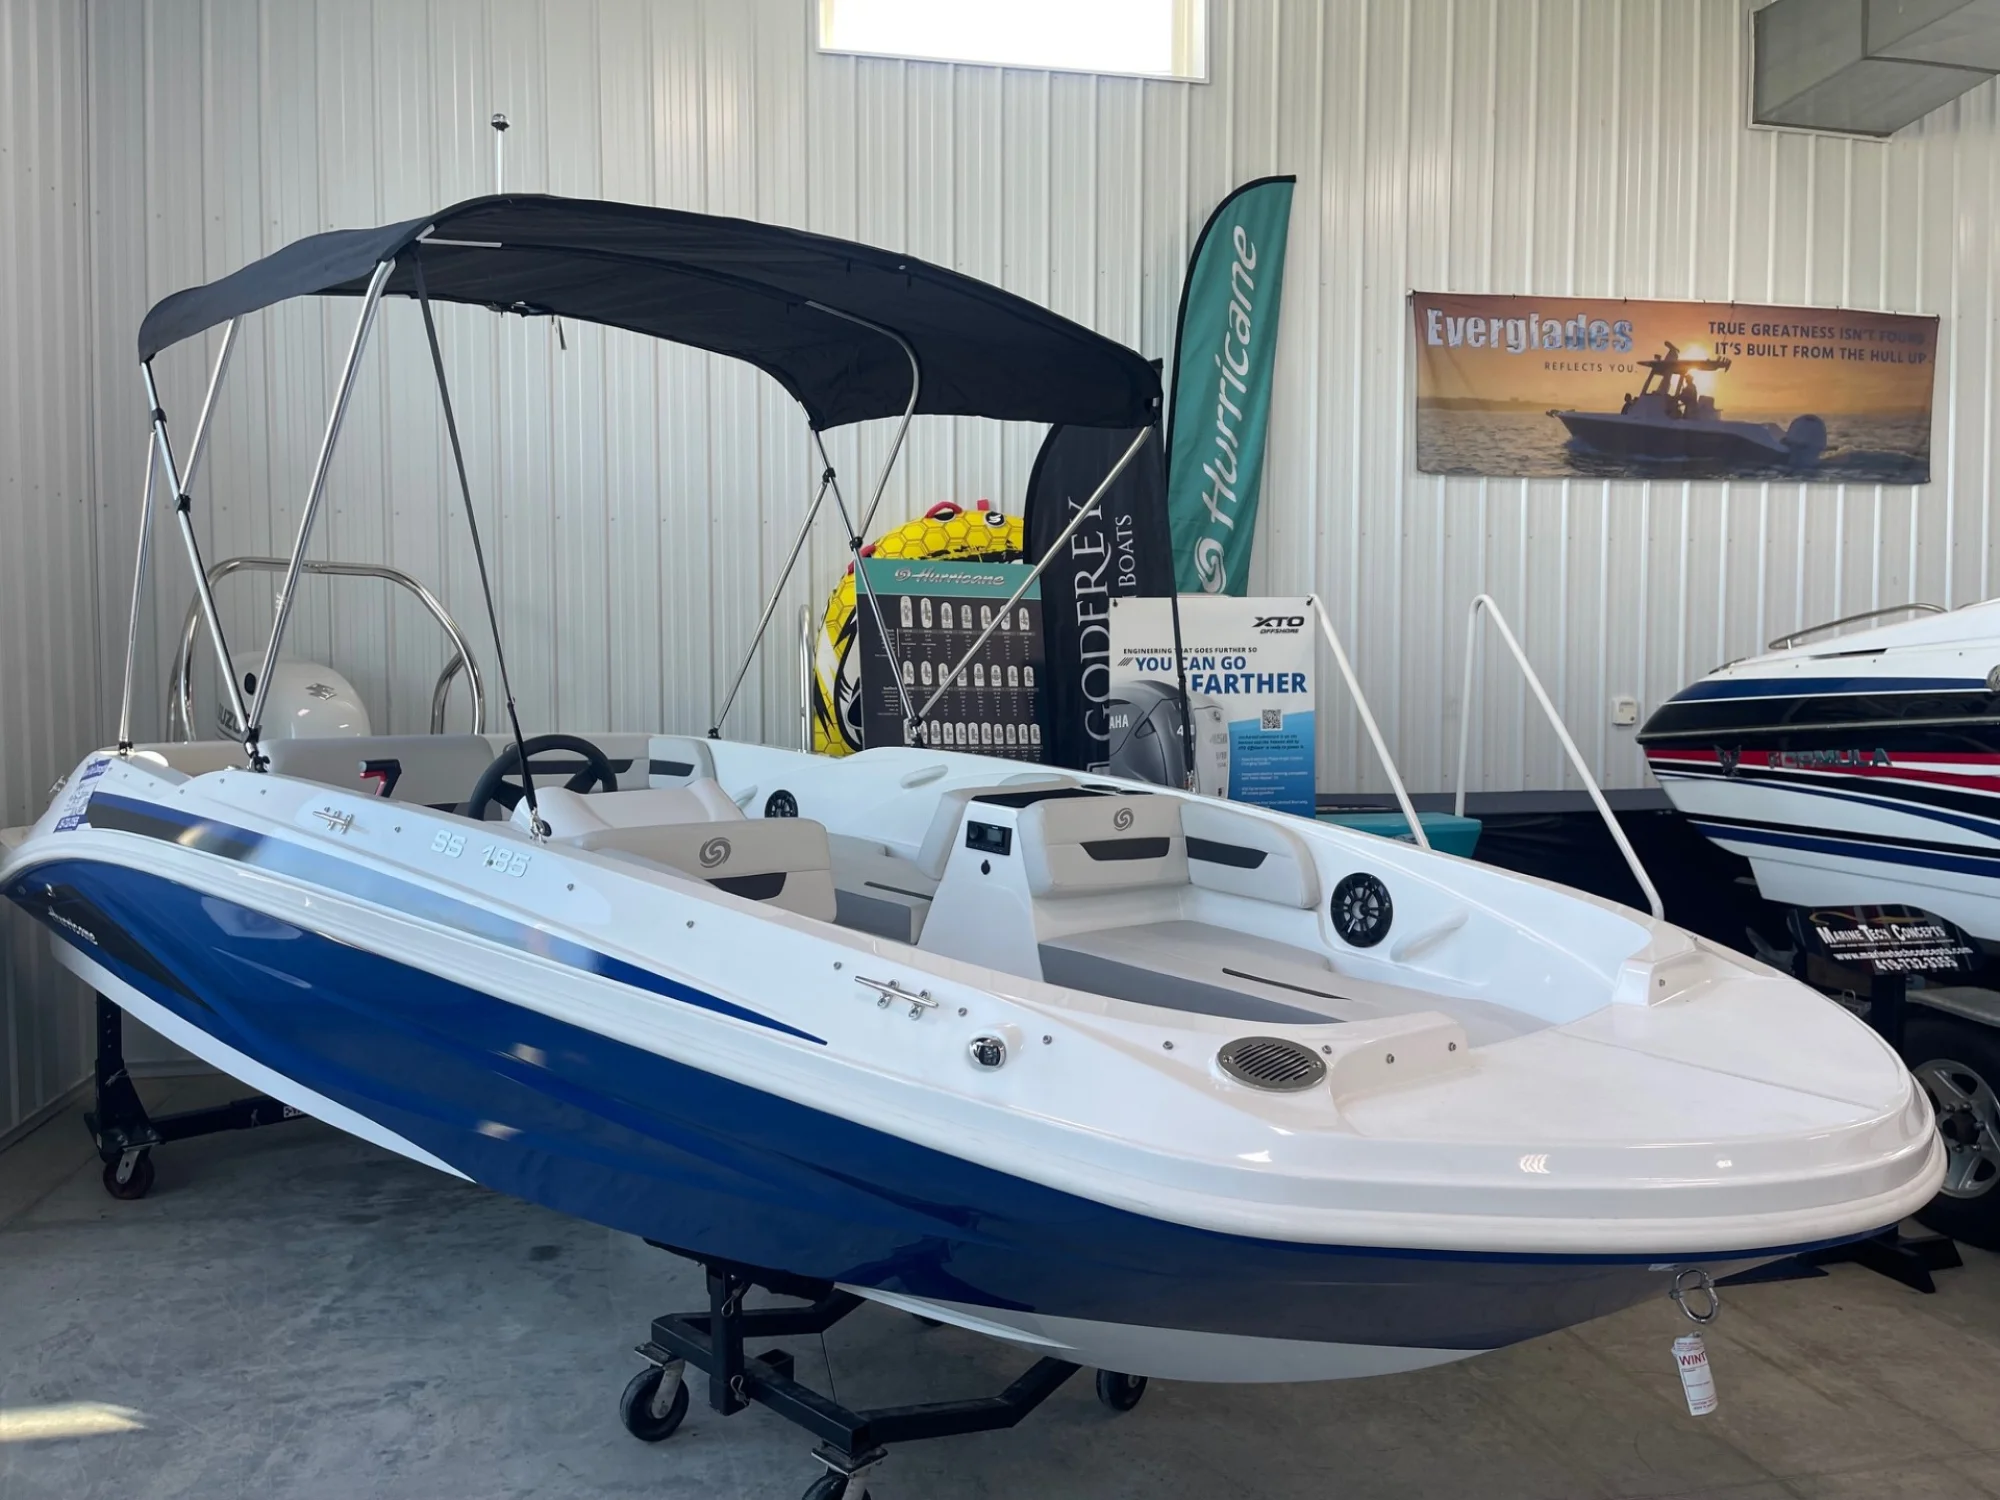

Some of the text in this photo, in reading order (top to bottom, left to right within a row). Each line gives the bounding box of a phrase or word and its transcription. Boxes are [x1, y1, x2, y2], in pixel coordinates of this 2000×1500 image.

[1426, 307, 1633, 354] Everglades
[1709, 321, 1746, 336] TRUE
[1751, 323, 1835, 339] GREATNESS
[1747, 343, 1788, 357] BUILT
[1793, 345, 1834, 359] FROM
[1841, 347, 1865, 360] THE
[1871, 349, 1903, 363] HULL
[1544, 361, 1603, 372] REFLECTS
[1203, 225, 1257, 530] Hurricane
[1115, 514, 1137, 587] BOATS
[912, 567, 1005, 585] Hurricane
[1252, 616, 1304, 628] XTO
[1135, 657, 1172, 671] YOU
[1221, 656, 1246, 670] GO
[1191, 672, 1307, 695] FARTHER
[1176, 724, 1195, 736] 40
[1767, 747, 1893, 770] FORMULA
[431, 829, 532, 877] SS 185
[1815, 926, 1865, 944] MARINE
[1890, 923, 1946, 941] CONCEPTS
